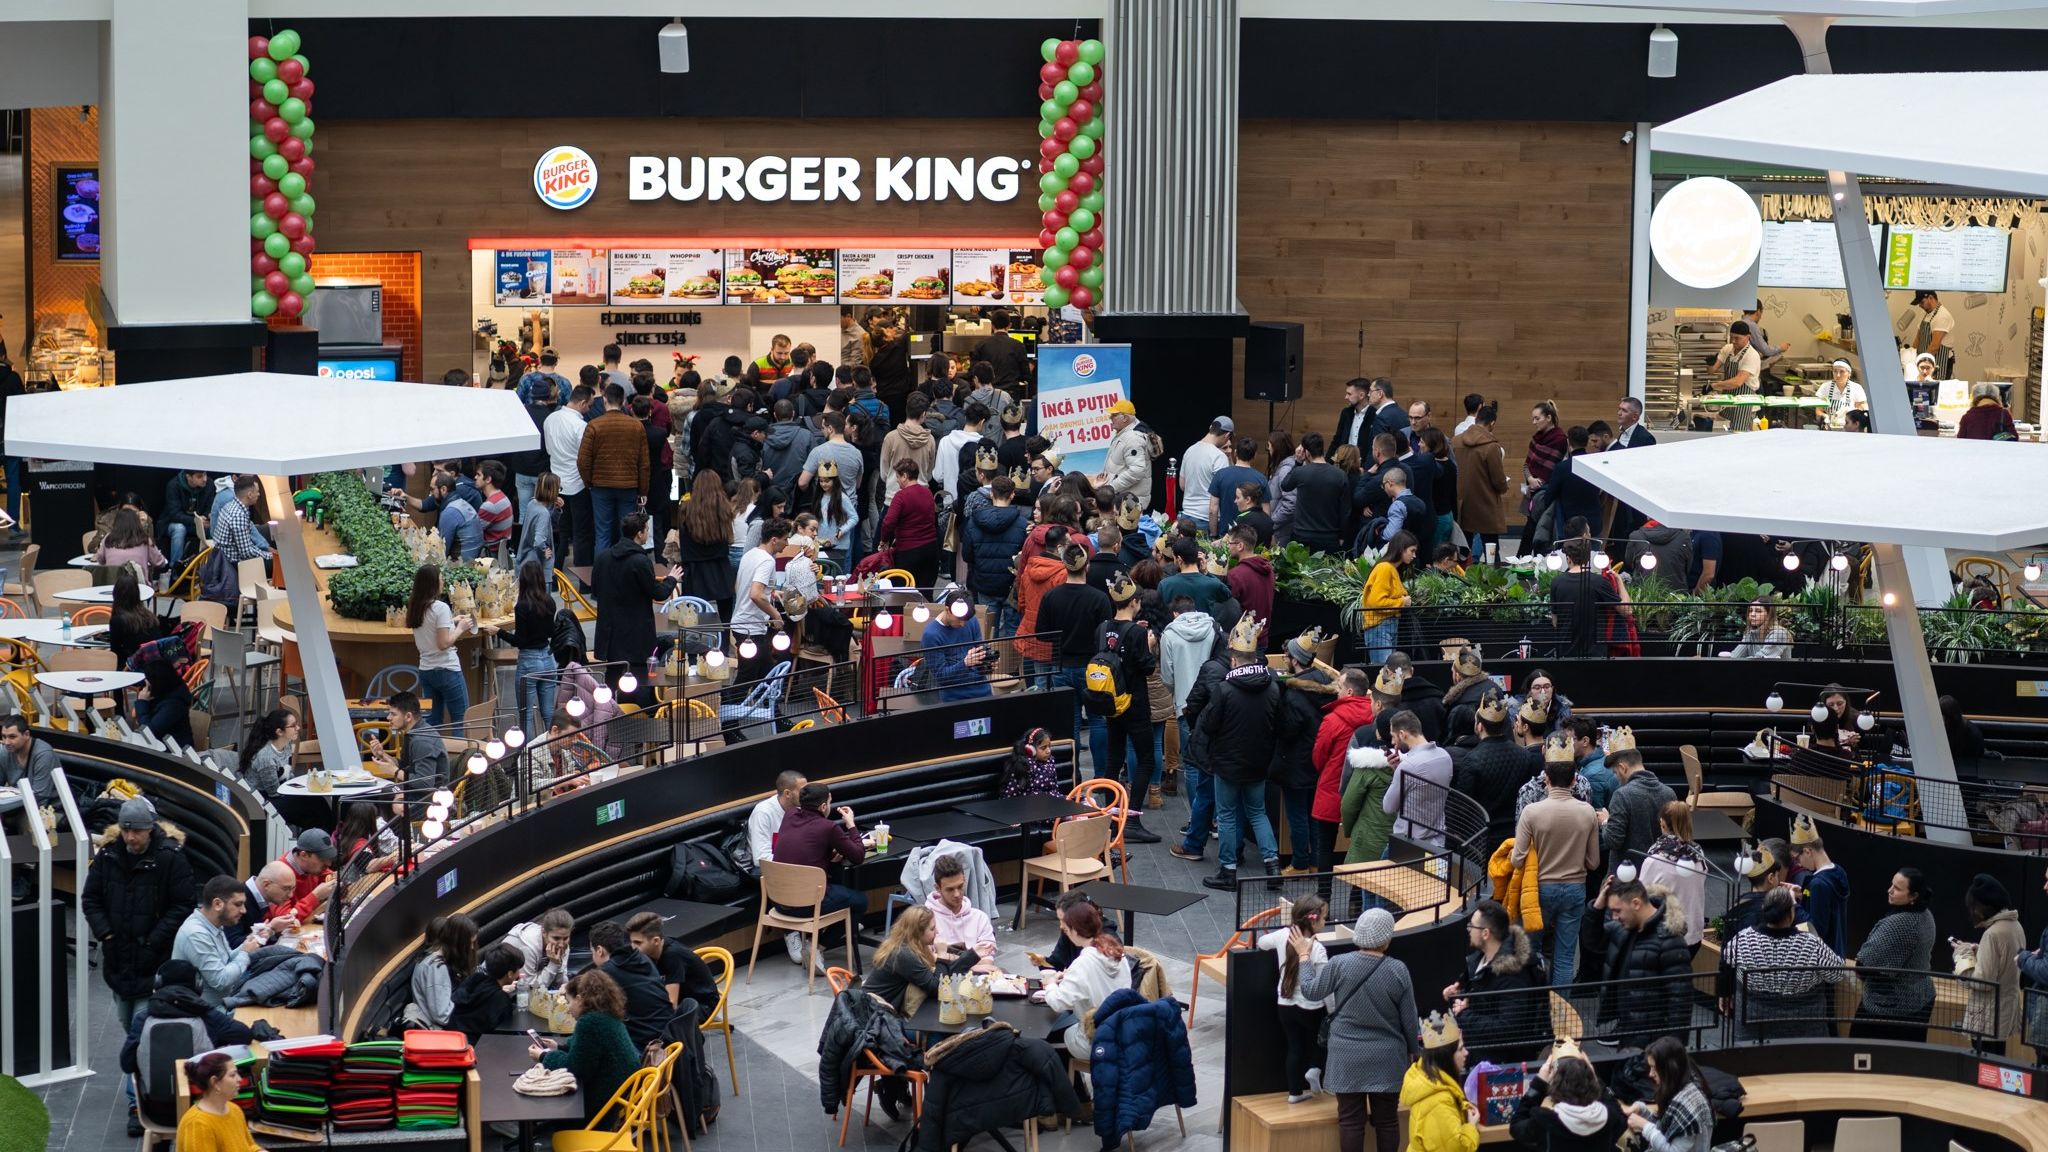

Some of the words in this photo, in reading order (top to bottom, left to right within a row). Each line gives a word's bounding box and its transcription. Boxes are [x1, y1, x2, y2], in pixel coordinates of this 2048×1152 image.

[543, 159, 588, 180] BURGER
[629, 155, 861, 202] BURGER
[875, 155, 1020, 202] KING
[545, 169, 590, 195] KING
[601, 312, 640, 325] FLAME
[644, 312, 702, 325] GRILLING
[616, 332, 650, 345] SINCE
[654, 332, 686, 345] 1954
[1077, 363, 1094, 371] KING
[1041, 398, 1075, 418] ÎNCĂ
